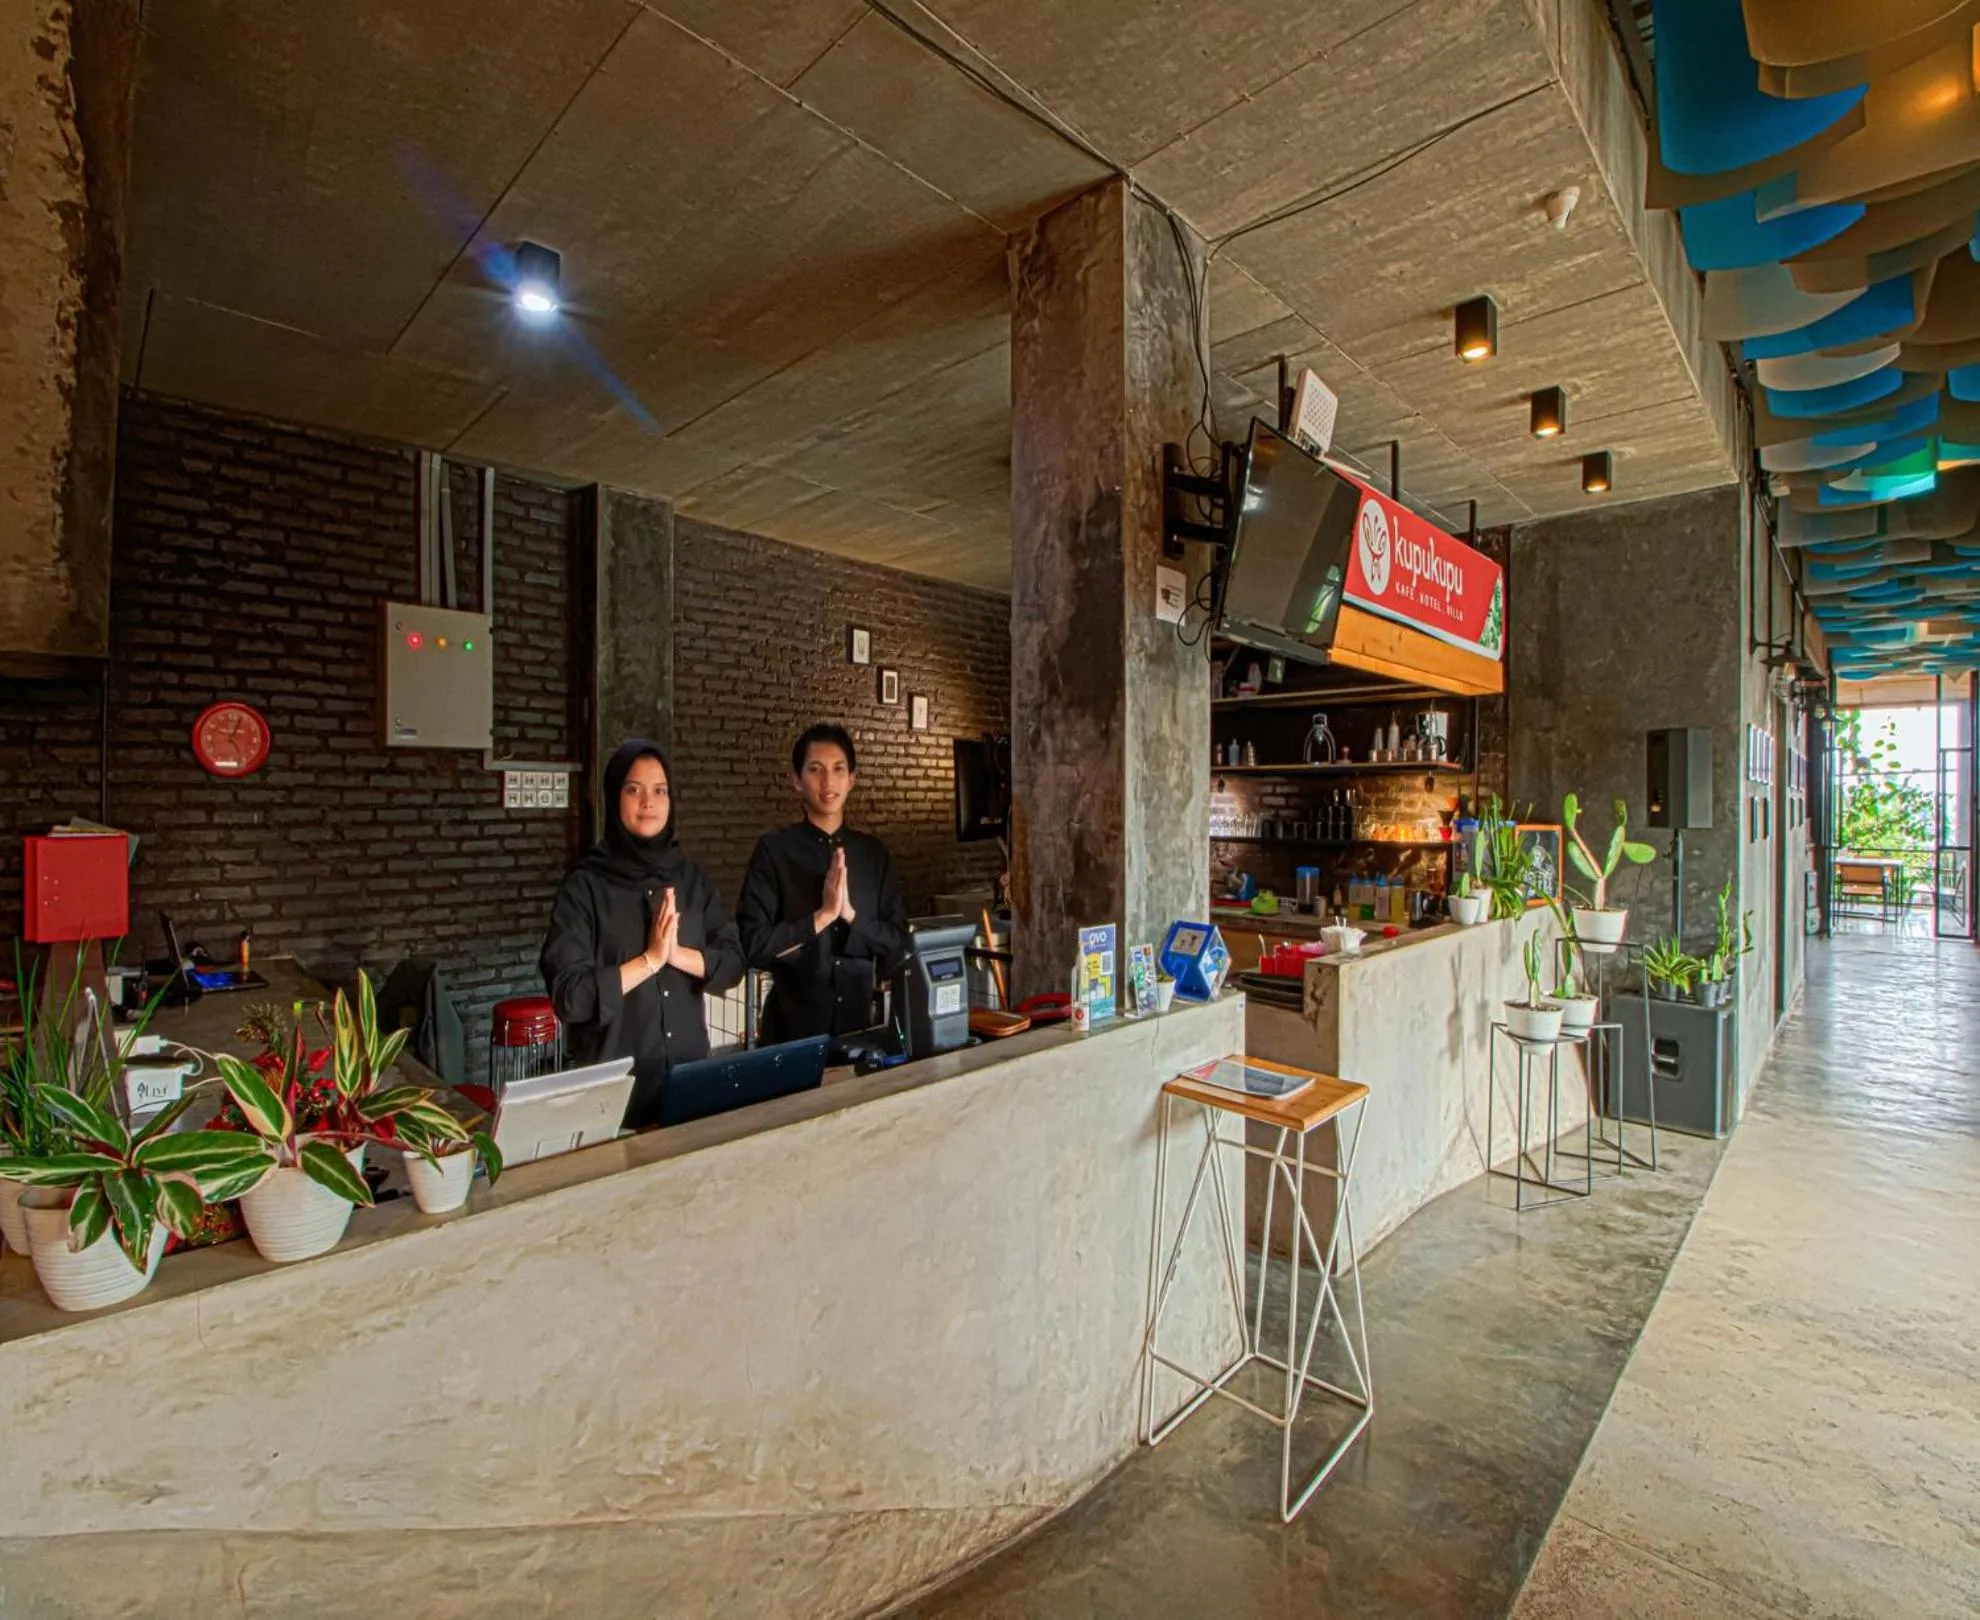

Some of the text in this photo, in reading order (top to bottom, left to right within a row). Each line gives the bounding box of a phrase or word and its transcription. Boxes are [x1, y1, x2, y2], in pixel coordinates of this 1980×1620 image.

[1394, 515, 1463, 604] kupukupu
[1419, 592, 1442, 612] HOTEL
[1446, 603, 1464, 622] VILLA
